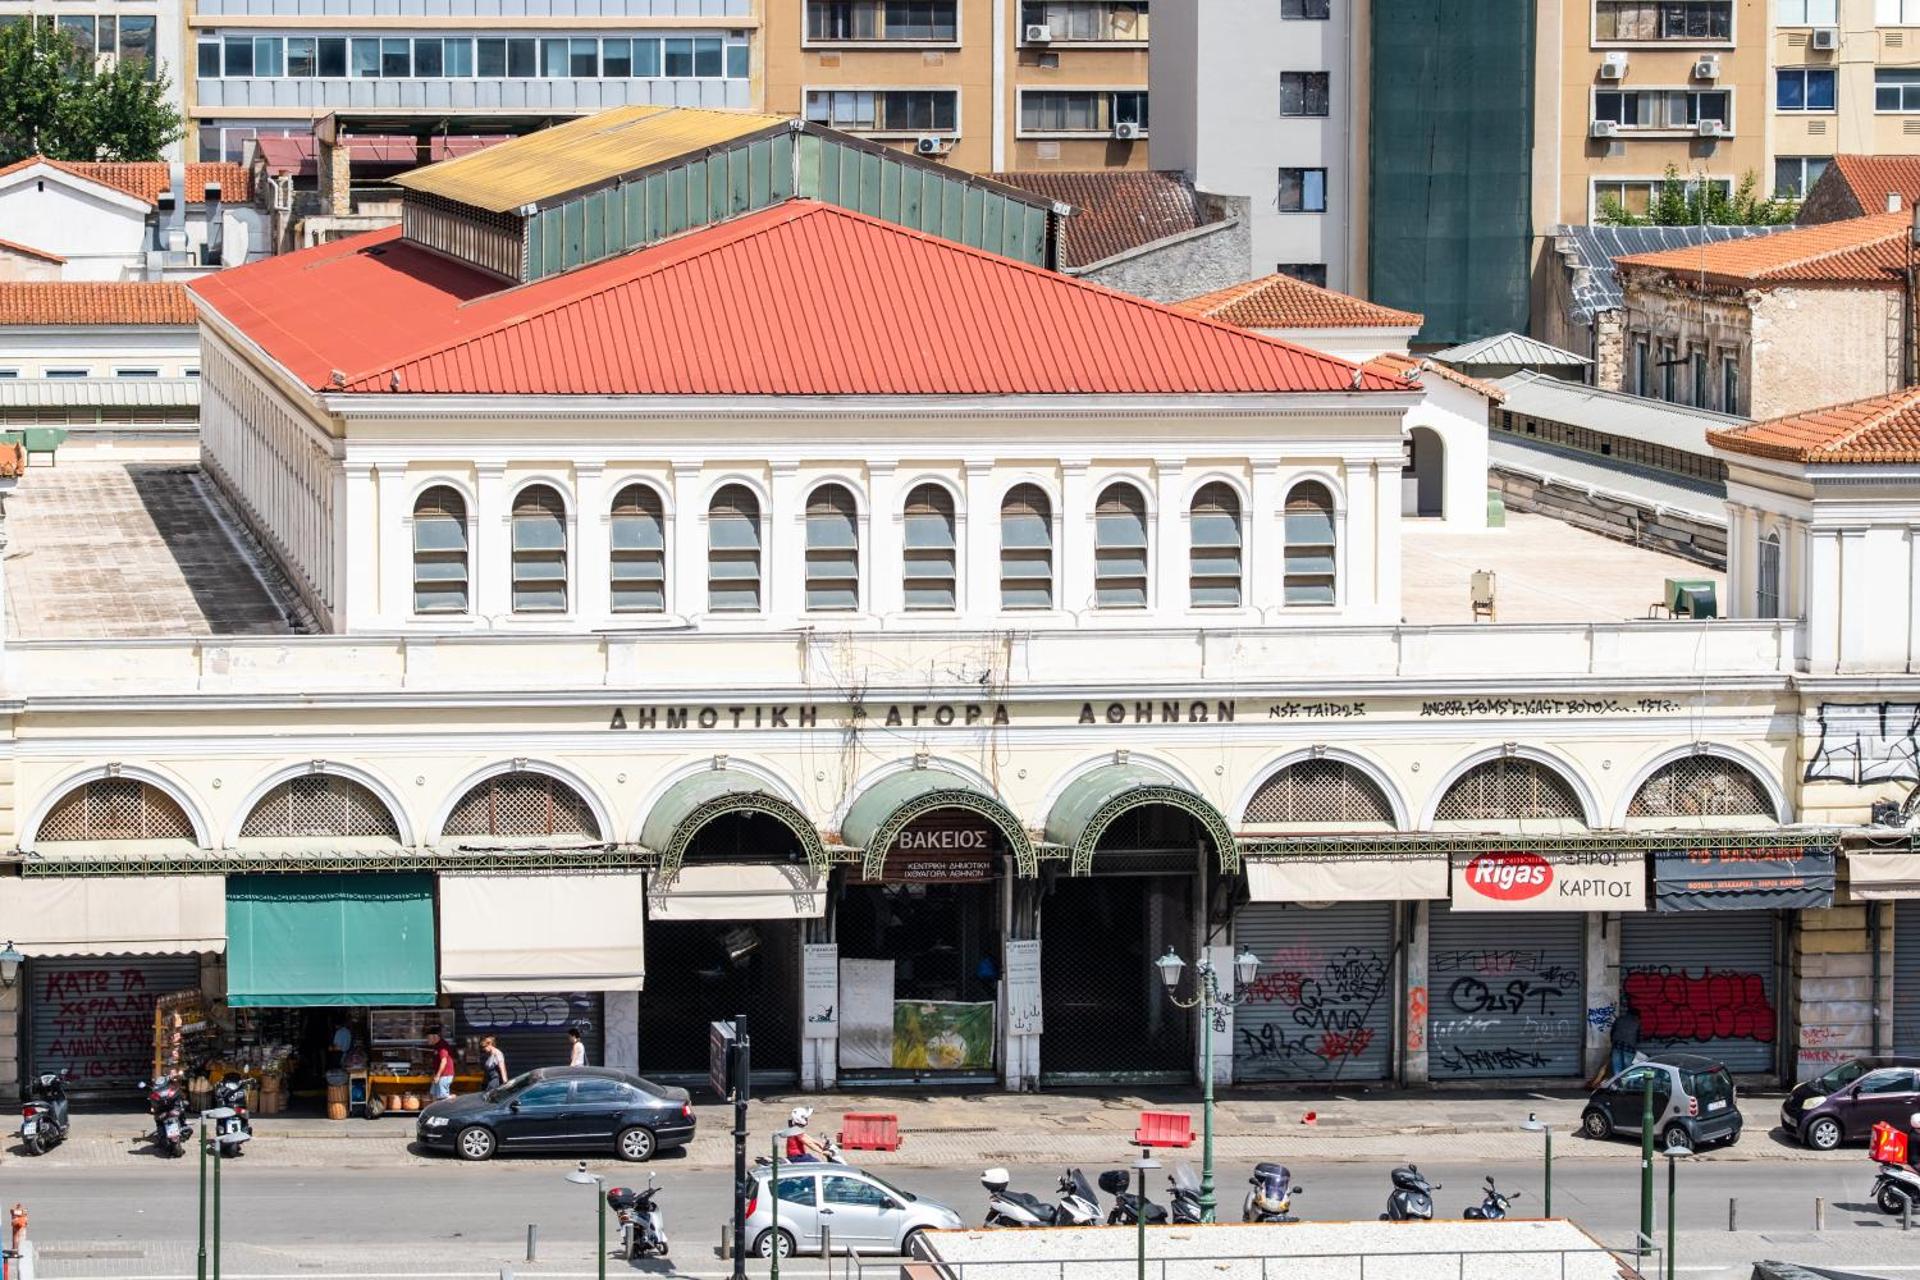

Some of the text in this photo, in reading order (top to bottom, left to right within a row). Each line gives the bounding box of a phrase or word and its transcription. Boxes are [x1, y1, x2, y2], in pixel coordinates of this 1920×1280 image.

[609, 700, 1235, 730] ΔΗΜΟΤΙΚΗ ΑΓΟΡΑ ΑΘΗΝΩΝ
[1474, 859, 1546, 890] Rigas
[1559, 880, 1632, 898] ΚΑΡΠΟΙ
